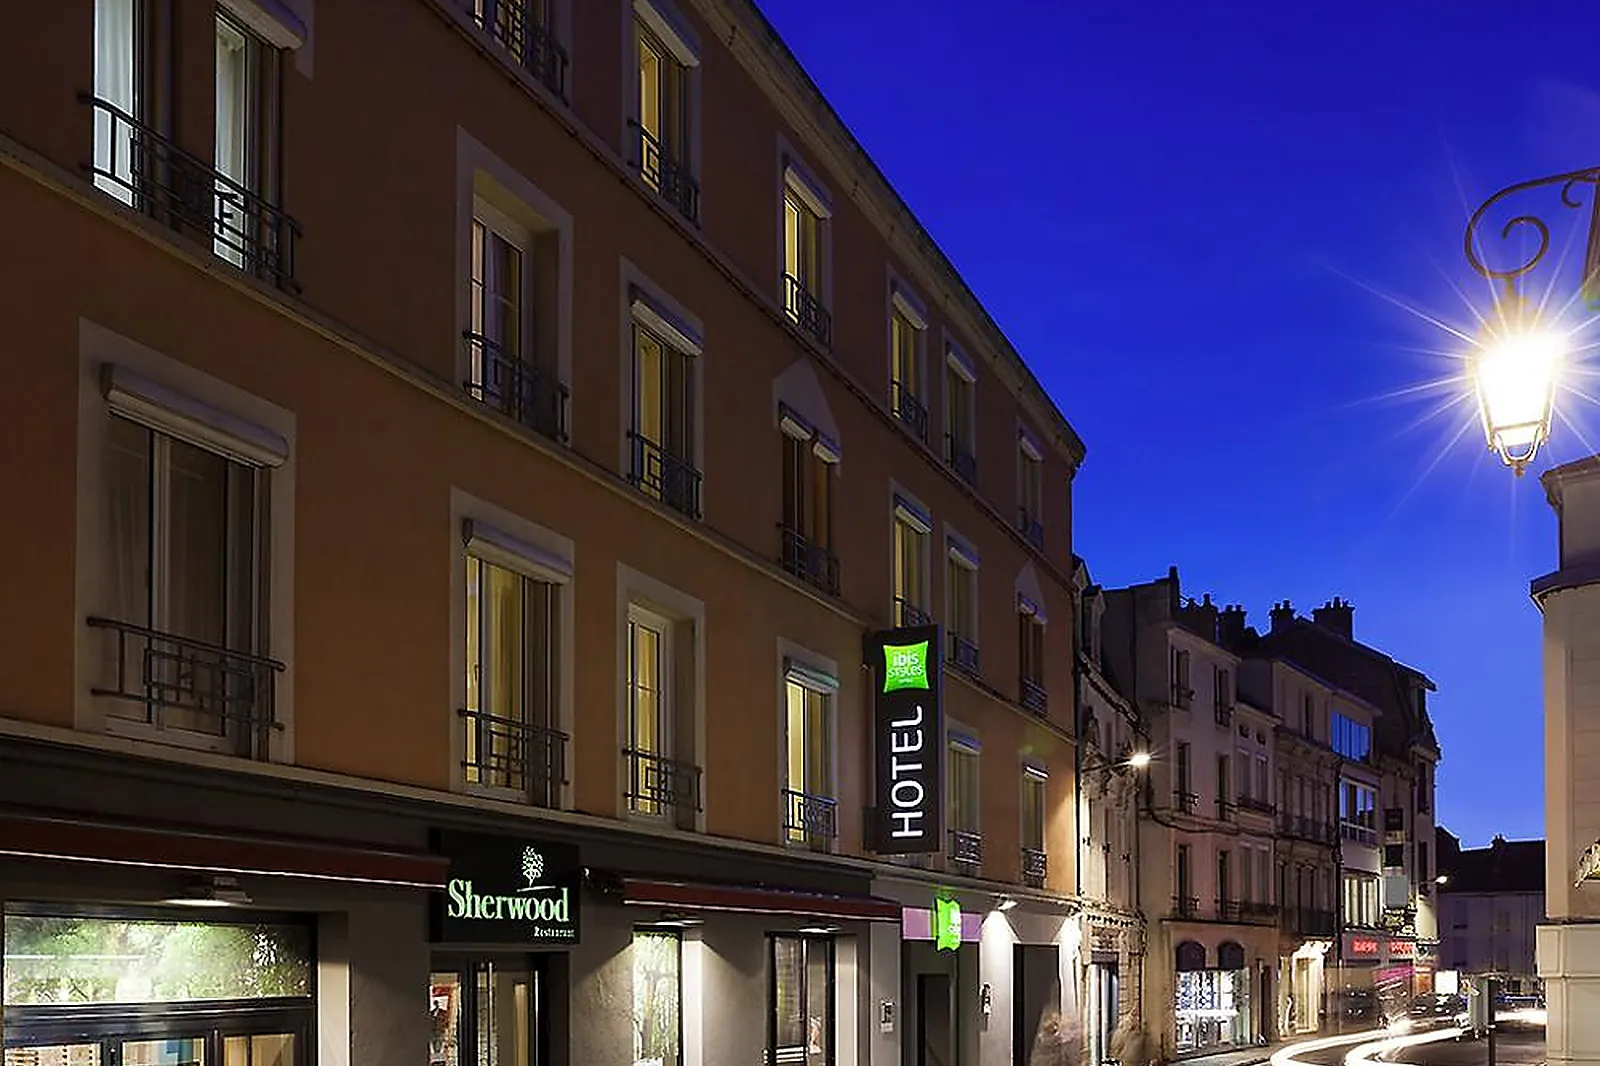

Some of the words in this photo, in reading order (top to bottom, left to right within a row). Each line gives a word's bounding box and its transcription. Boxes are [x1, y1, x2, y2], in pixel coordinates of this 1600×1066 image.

[892, 649, 919, 666] ibis
[891, 705, 924, 838] HOTEL
[447, 878, 570, 922] Sherwood
